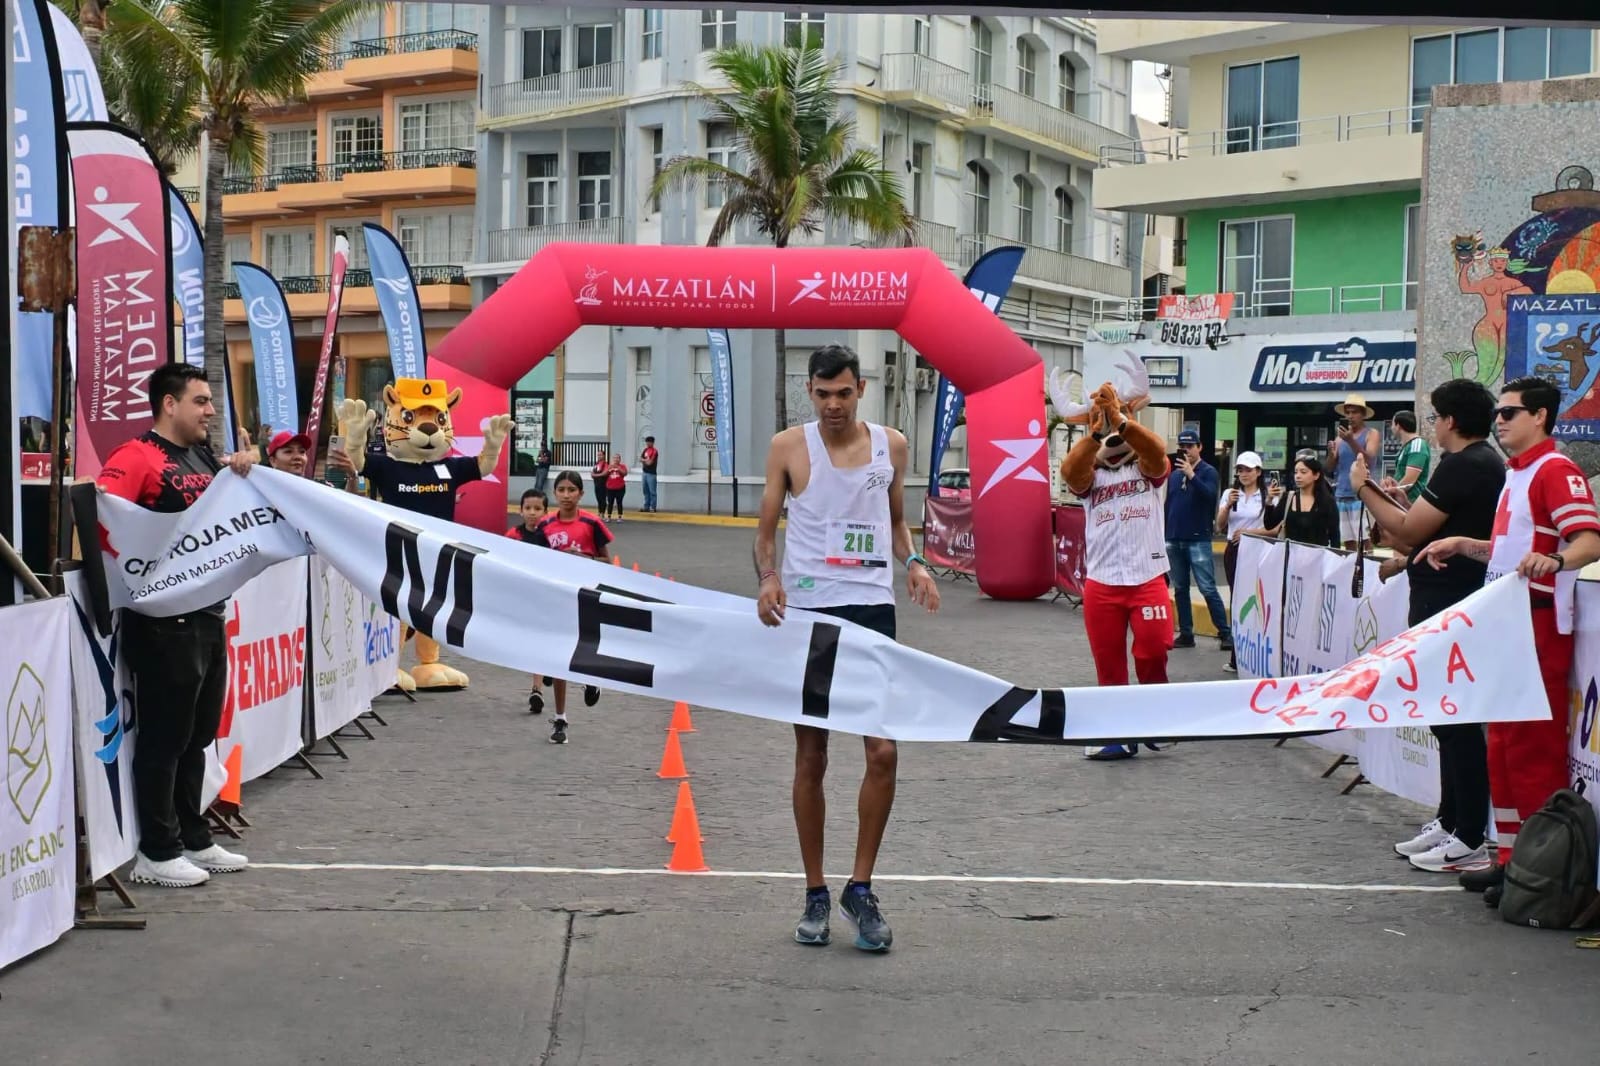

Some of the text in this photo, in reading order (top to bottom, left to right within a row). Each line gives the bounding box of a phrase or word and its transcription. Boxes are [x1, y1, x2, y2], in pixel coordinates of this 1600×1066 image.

[613, 275, 755, 299] MAZATLÁN
[831, 271, 908, 289] IMDEM
[830, 288, 907, 301] MAZATLÁN
[1512, 299, 1600, 312] MAZATL
[1306, 370, 1348, 380] SUSPENDIDO
[190, 543, 259, 579] MAZATLÁN
[1142, 605, 1167, 620] 911
[1330, 695, 1459, 730] 2026
